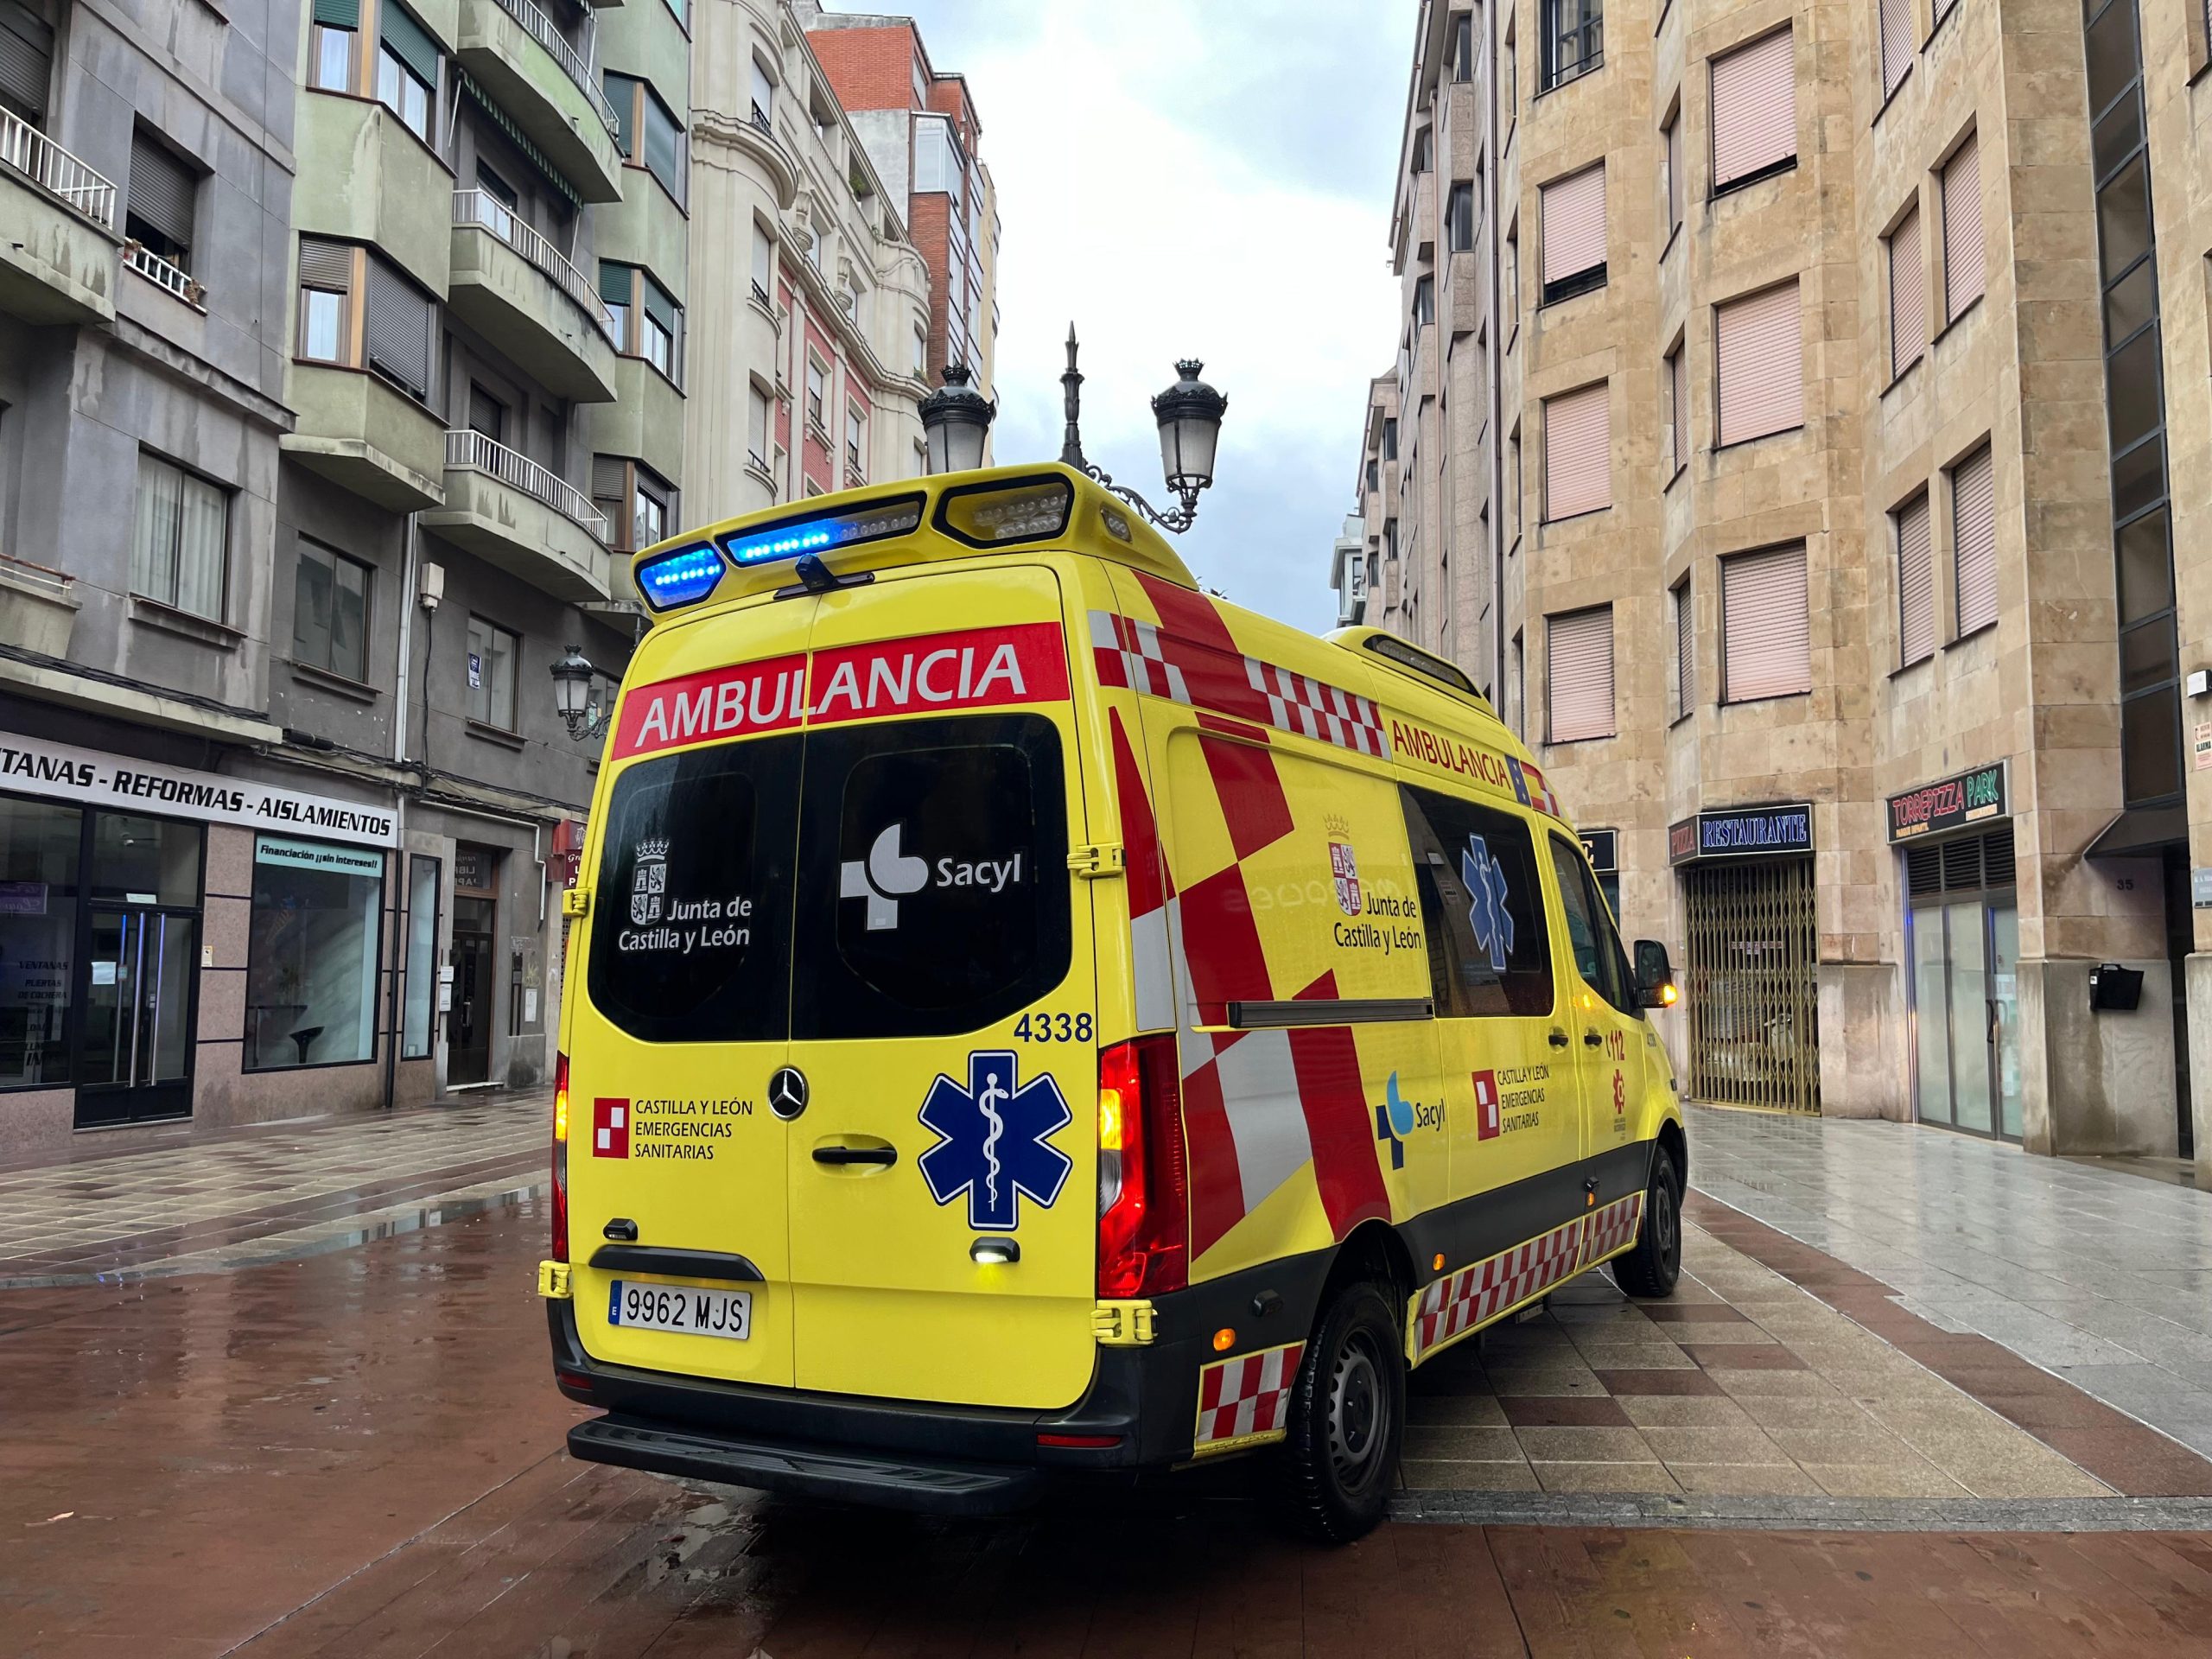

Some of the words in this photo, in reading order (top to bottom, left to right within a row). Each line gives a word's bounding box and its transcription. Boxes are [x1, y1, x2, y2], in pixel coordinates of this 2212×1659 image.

[634, 644, 1027, 748] AMBULANCIA
[1392, 720, 1511, 791] AMBULANCIA
[0, 748, 96, 787] TANAS
[112, 770, 245, 812] REFORMAS
[257, 797, 391, 836] AISLAMIENTOS
[1892, 781, 1965, 827] TORREPIZZA
[1967, 769, 1999, 808] PARK
[1671, 825, 1695, 857] PIZZA
[1703, 814, 1807, 848] RESTAURANTE
[260, 844, 315, 861] Financiación
[937, 853, 1020, 893] Sacyl
[2117, 879, 2134, 891] 35
[667, 899, 721, 921] Junta
[726, 896, 752, 918] de
[1366, 891, 1400, 917] Junta
[1402, 895, 1417, 918] de
[619, 928, 679, 950] Castilla
[683, 931, 696, 954] y
[701, 925, 750, 947] León
[1334, 922, 1381, 948] Castilla
[1382, 930, 1389, 956] y
[1392, 925, 1421, 950] León
[1014, 1013, 1092, 1043] 4338
[1610, 1029, 1625, 1062] 112
[1497, 1067, 1527, 1086] CASTILLA
[1532, 1062, 1549, 1082] LEÓN
[635, 1100, 696, 1115] CASTILLA
[699, 1100, 709, 1115] Y
[712, 1096, 753, 1116] LEÓN
[1501, 1088, 1545, 1109] EMERGENCIAS
[1415, 1098, 1446, 1132] Sacyl
[1502, 1111, 1539, 1134] SANITARIAS
[635, 1122, 732, 1138] EMERGENCIAS
[635, 1143, 714, 1160] SANITARIAS
[611, 1306, 617, 1316] E
[626, 1288, 686, 1326] 9962
[695, 1295, 743, 1332] MJS
